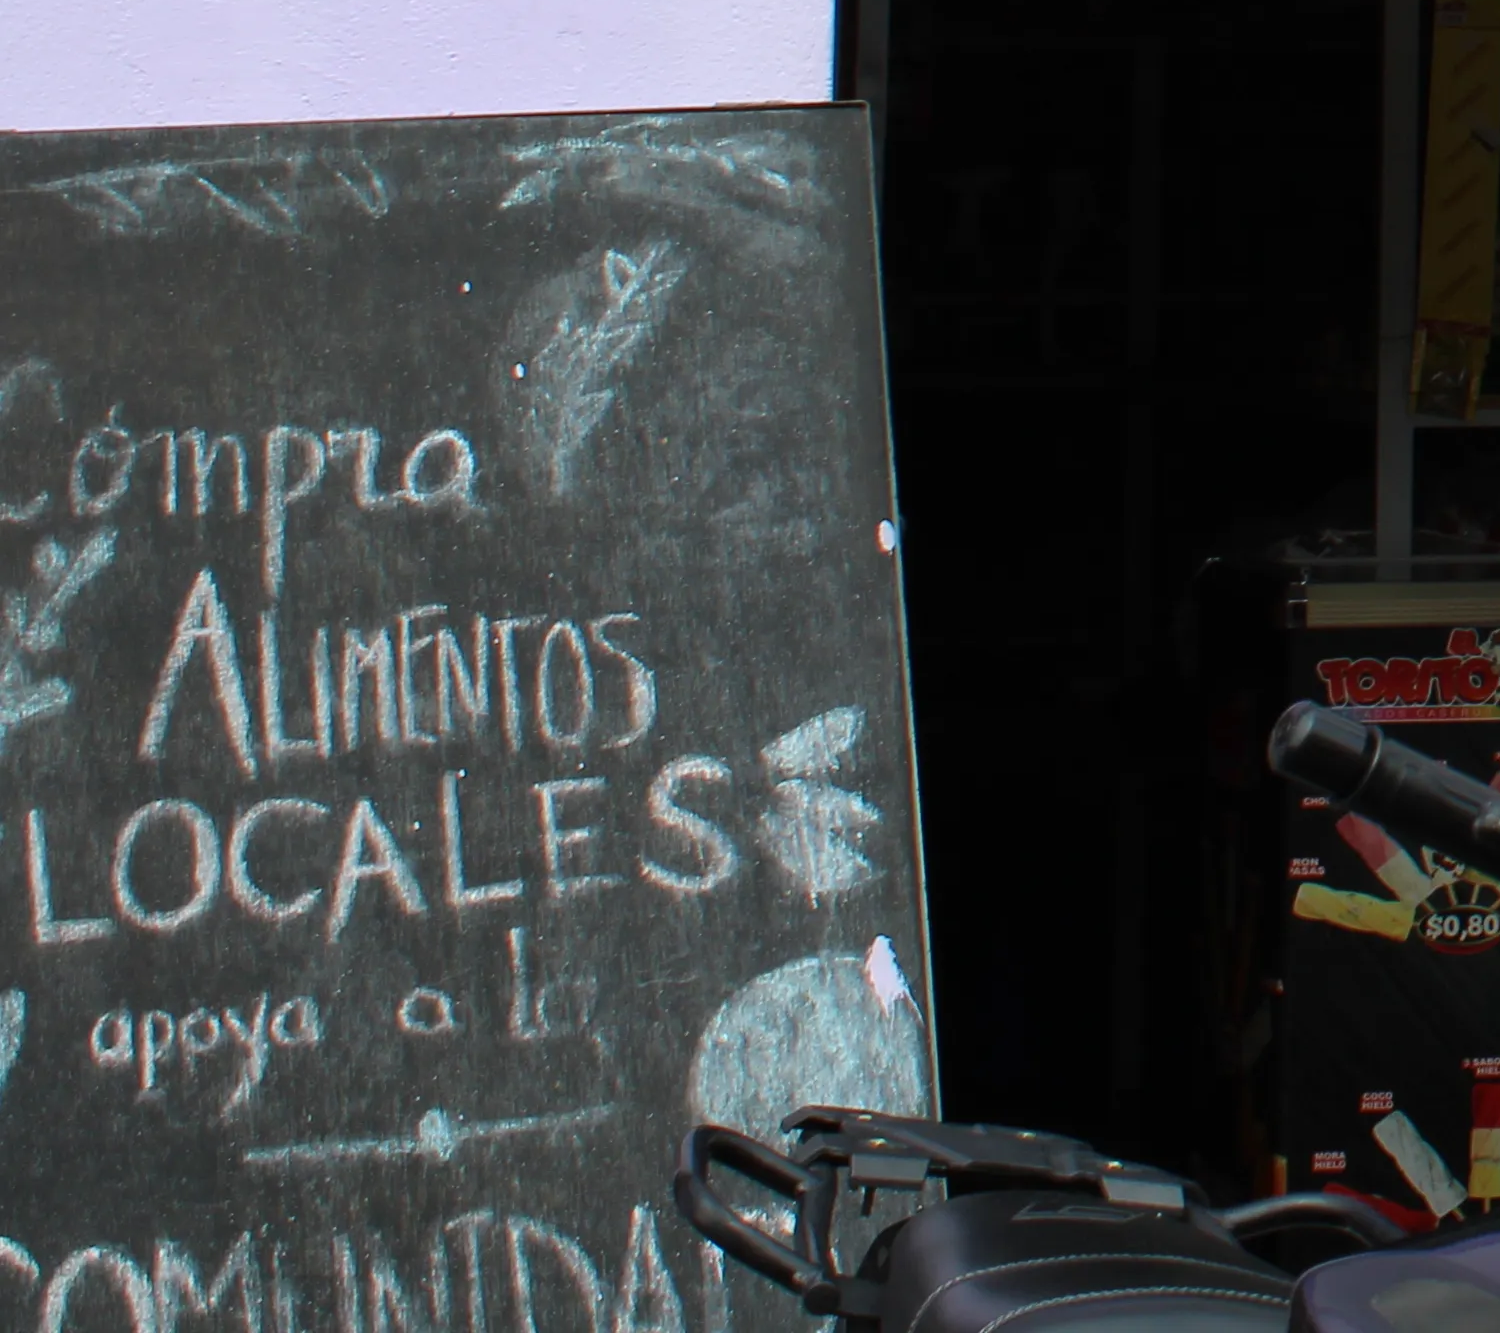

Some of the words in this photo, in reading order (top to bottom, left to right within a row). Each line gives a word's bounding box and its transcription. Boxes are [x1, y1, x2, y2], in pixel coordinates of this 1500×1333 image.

[141, 569, 657, 779] ALIMENTOS
[26, 753, 742, 943] LOCALES
[1426, 912, 1500, 940] $0,80
[89, 991, 327, 1121] apoya
[1361, 1100, 1393, 1111] HIELO
[1363, 1092, 1393, 1101] COCO
[1314, 1160, 1345, 1170] HIELO
[1315, 1151, 1345, 1160] MORA
